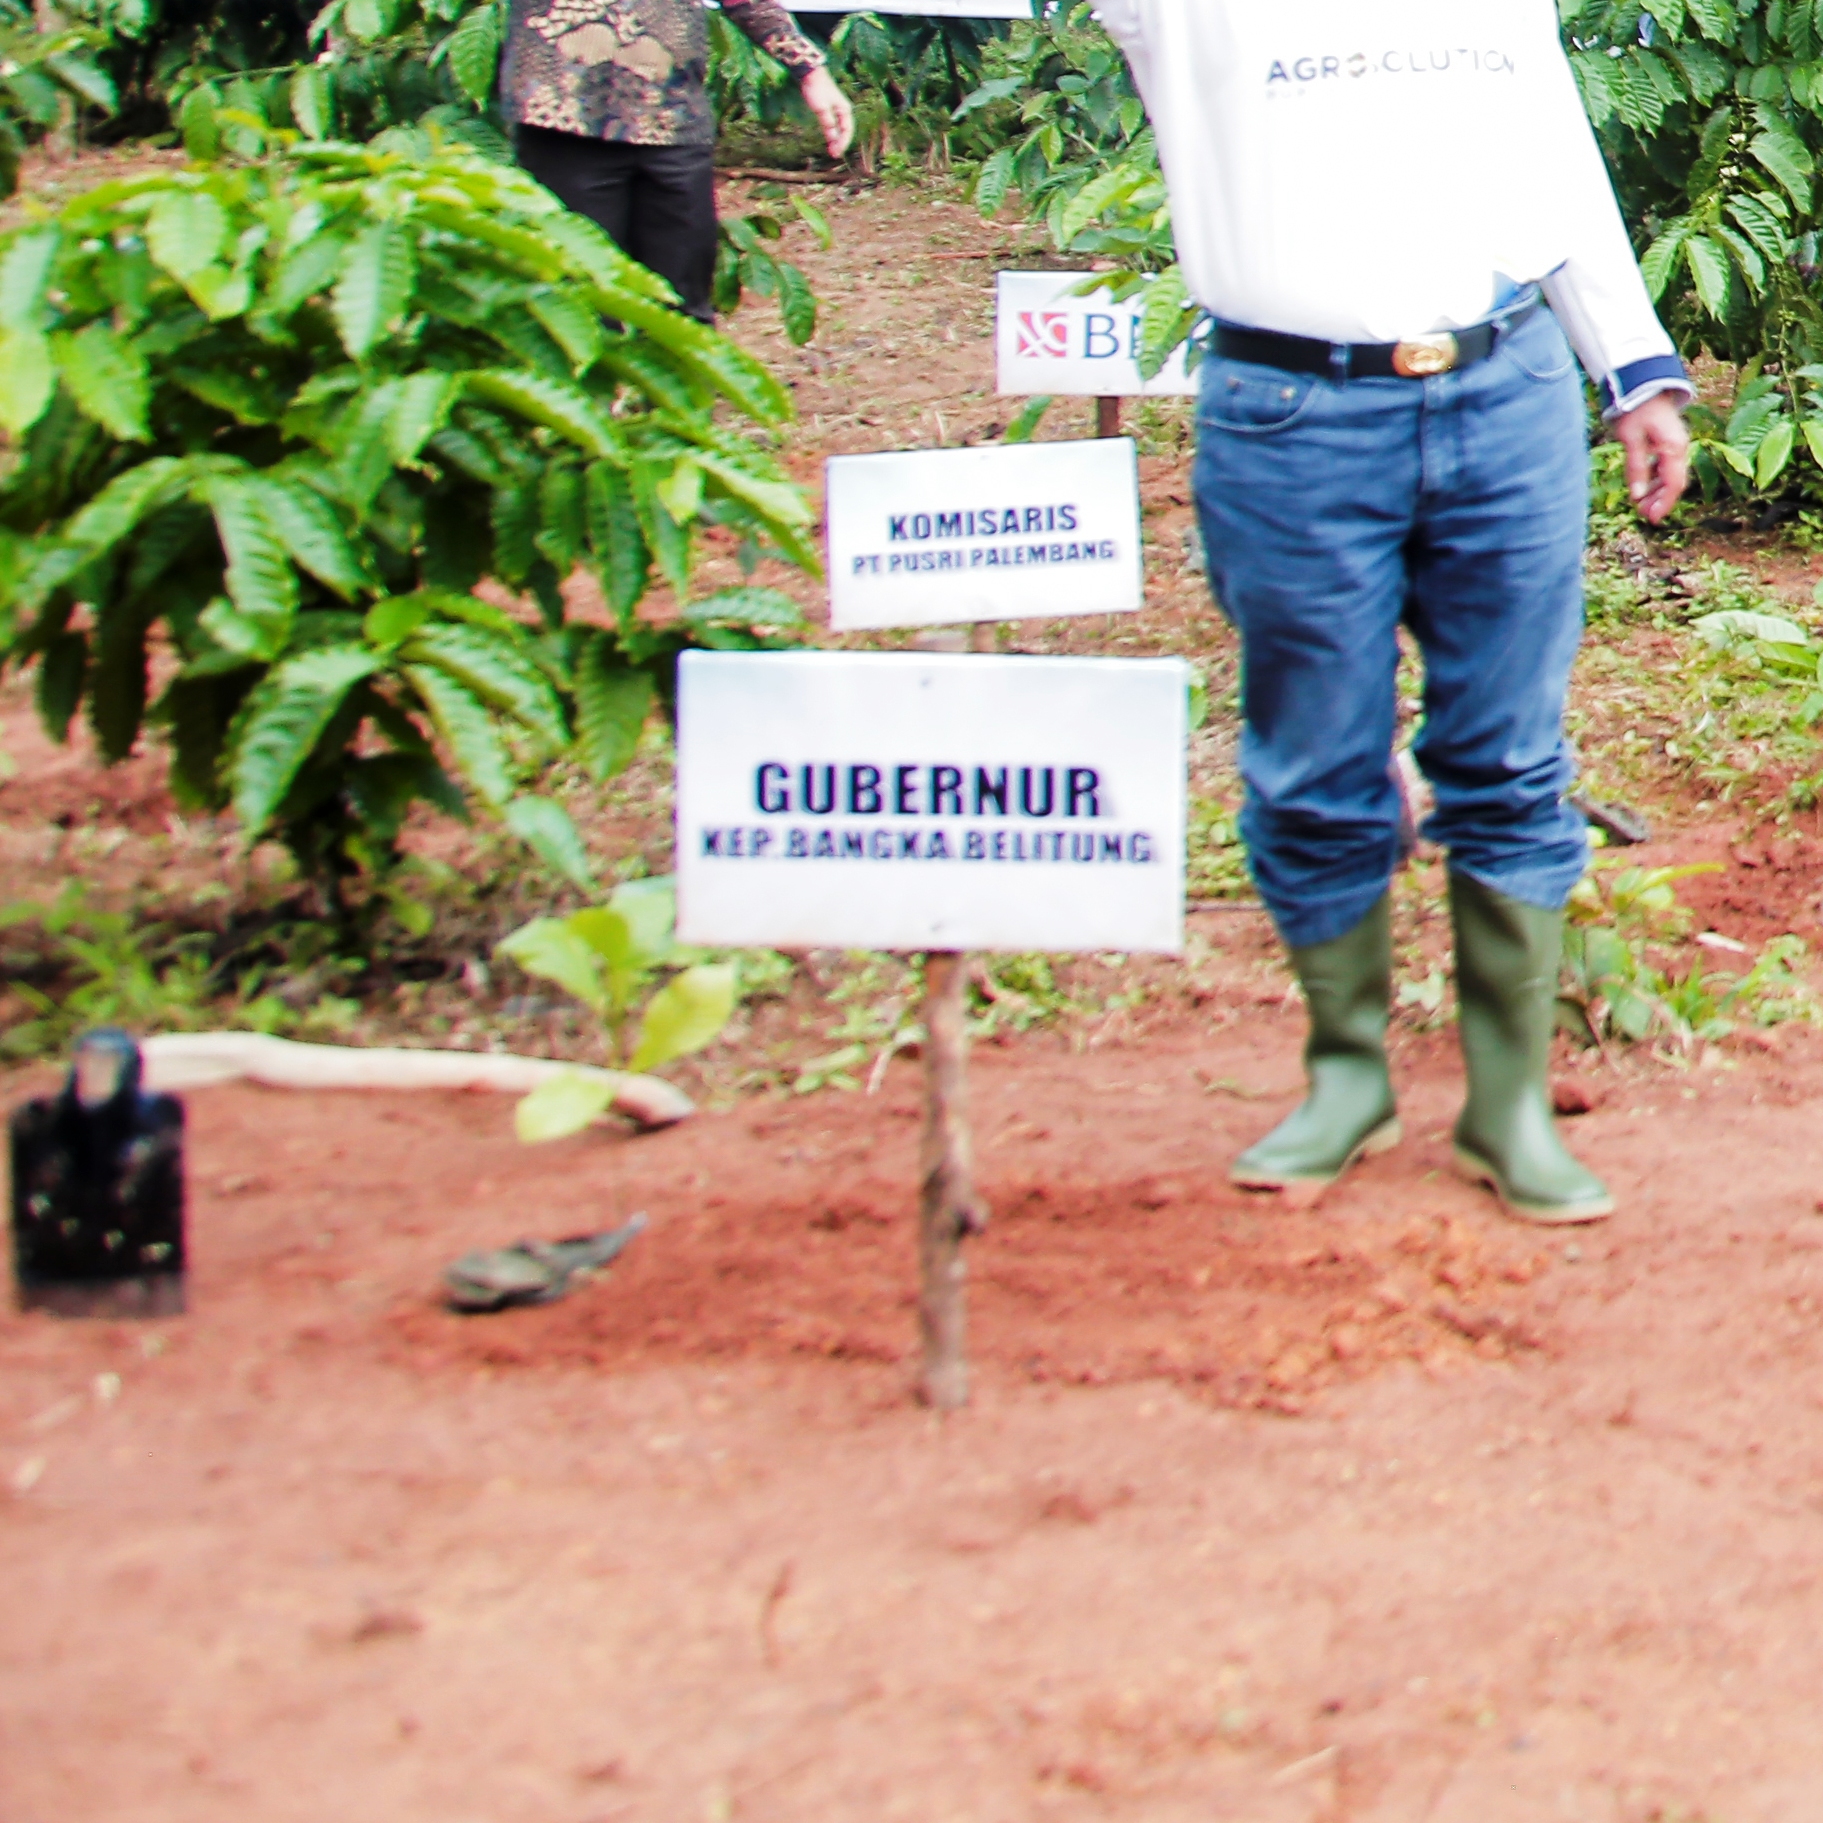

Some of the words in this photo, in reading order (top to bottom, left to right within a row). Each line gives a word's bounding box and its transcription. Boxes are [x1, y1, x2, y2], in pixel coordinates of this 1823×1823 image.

[1265, 48, 1515, 85] AGROOLUION
[889, 504, 1077, 541] KOMISARIS
[852, 555, 880, 574] PT
[889, 551, 962, 572] PUSRI
[969, 540, 1115, 567] PALEMBANG
[755, 762, 1102, 818] GUBERNUR
[783, 828, 946, 859] BANGKA
[962, 830, 1152, 863] BELITUNG
